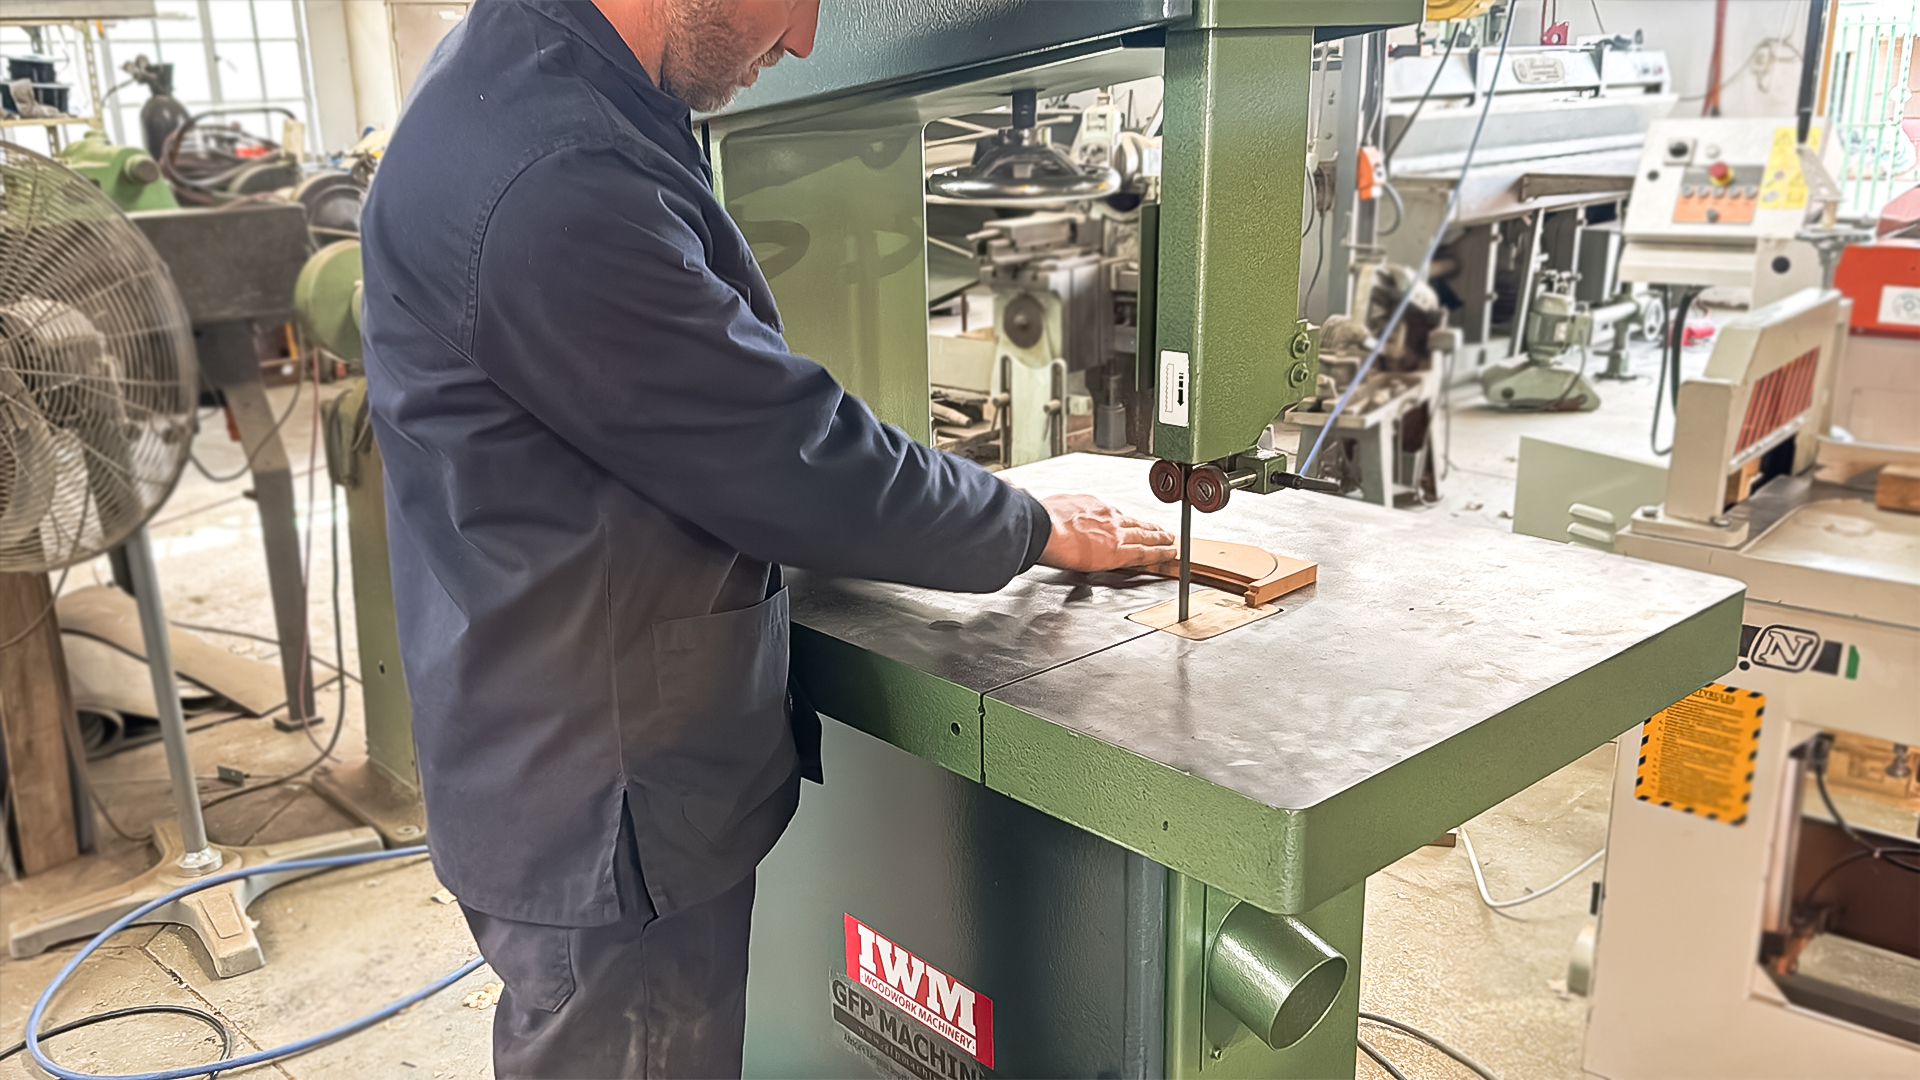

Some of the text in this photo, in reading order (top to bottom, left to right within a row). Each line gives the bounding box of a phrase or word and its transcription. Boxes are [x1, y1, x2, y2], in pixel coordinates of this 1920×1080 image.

[1759, 630, 1814, 666] N
[857, 923, 977, 1037] IWM
[863, 973, 972, 1049] WOODWORK MACHINERY
[832, 979, 874, 1021] GFP
[879, 1006, 984, 1080] MACHIN
